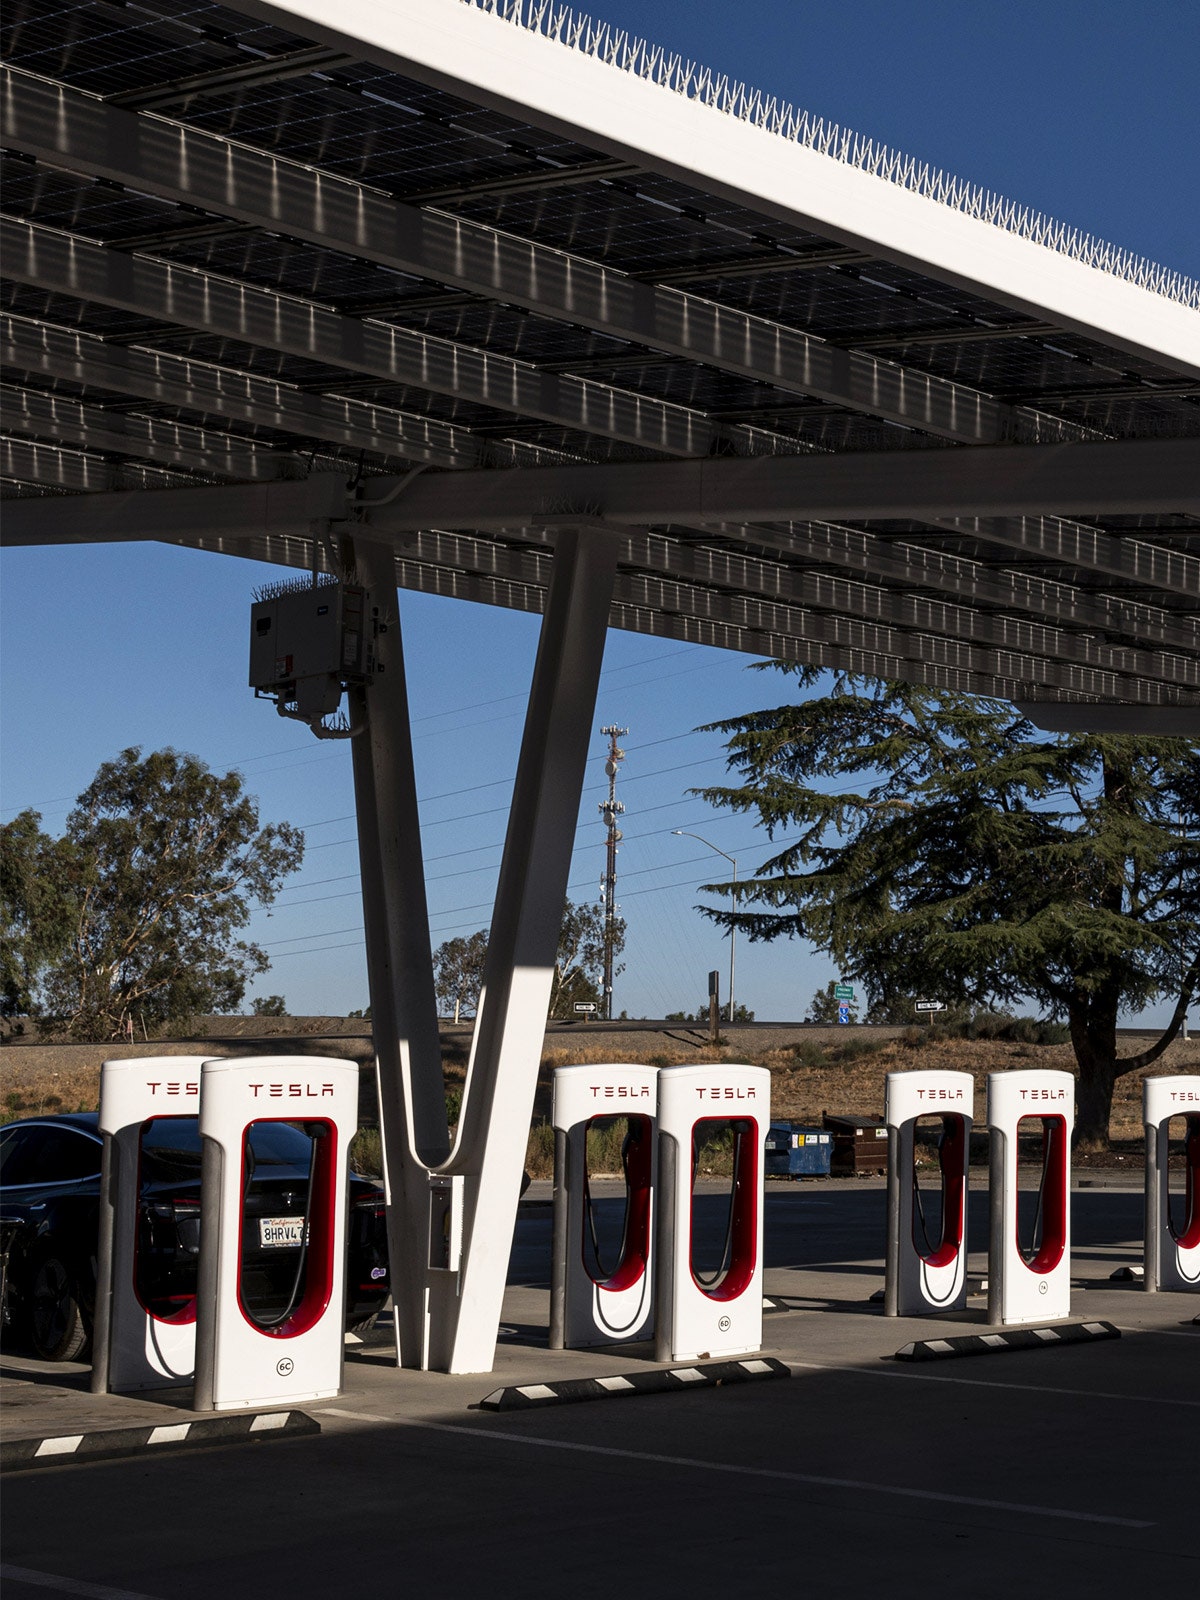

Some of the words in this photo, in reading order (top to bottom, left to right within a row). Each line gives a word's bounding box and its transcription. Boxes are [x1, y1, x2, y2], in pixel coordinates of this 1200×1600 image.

[147, 1083, 199, 1096] TES
[249, 1084, 334, 1097] TESLA
[589, 1086, 650, 1097] TESLA
[696, 1087, 756, 1099] TESLA
[917, 1090, 963, 1099] TESLA
[1019, 1090, 1065, 1099] TESLA
[279, 1362, 291, 1371] 6C
